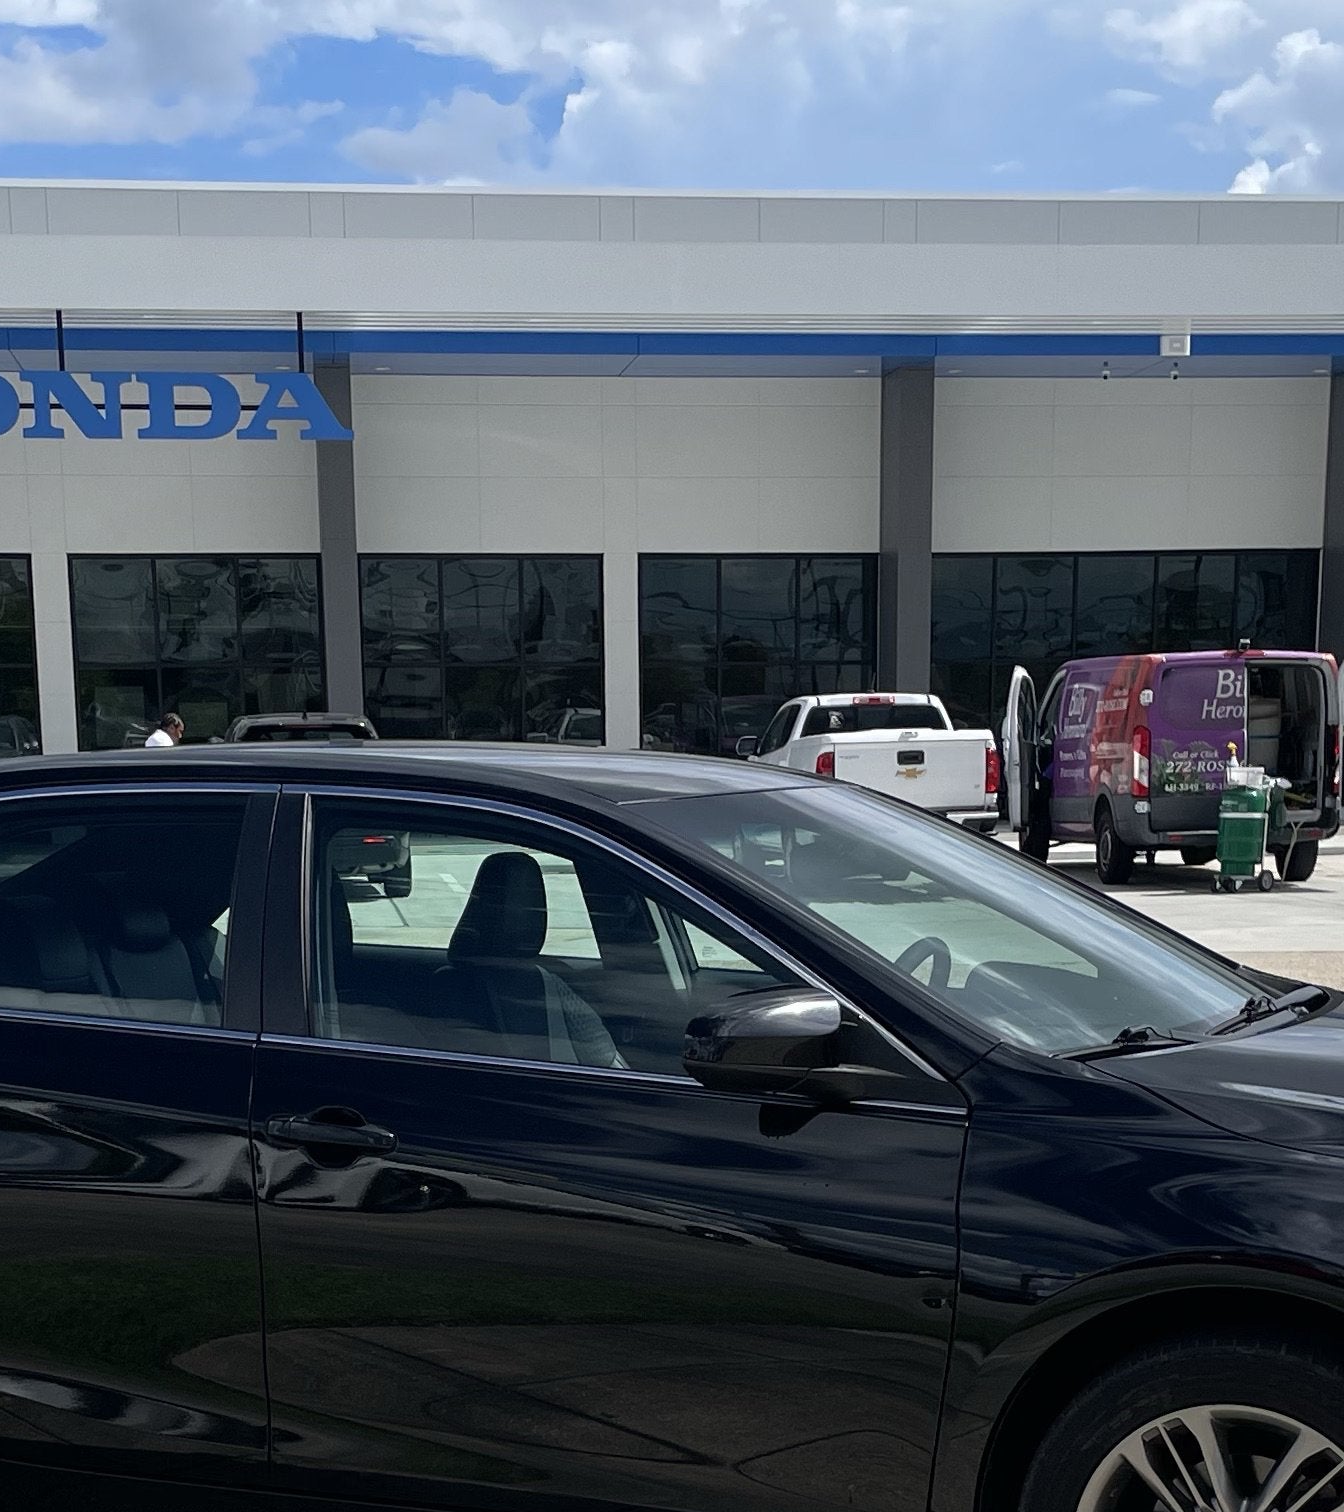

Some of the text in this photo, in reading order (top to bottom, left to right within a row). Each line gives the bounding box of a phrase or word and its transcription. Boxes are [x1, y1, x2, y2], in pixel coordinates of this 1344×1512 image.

[1216, 669, 1244, 698] Bi
[1201, 698, 1244, 720] Hero
[1165, 760, 1226, 773] 272-ROS
